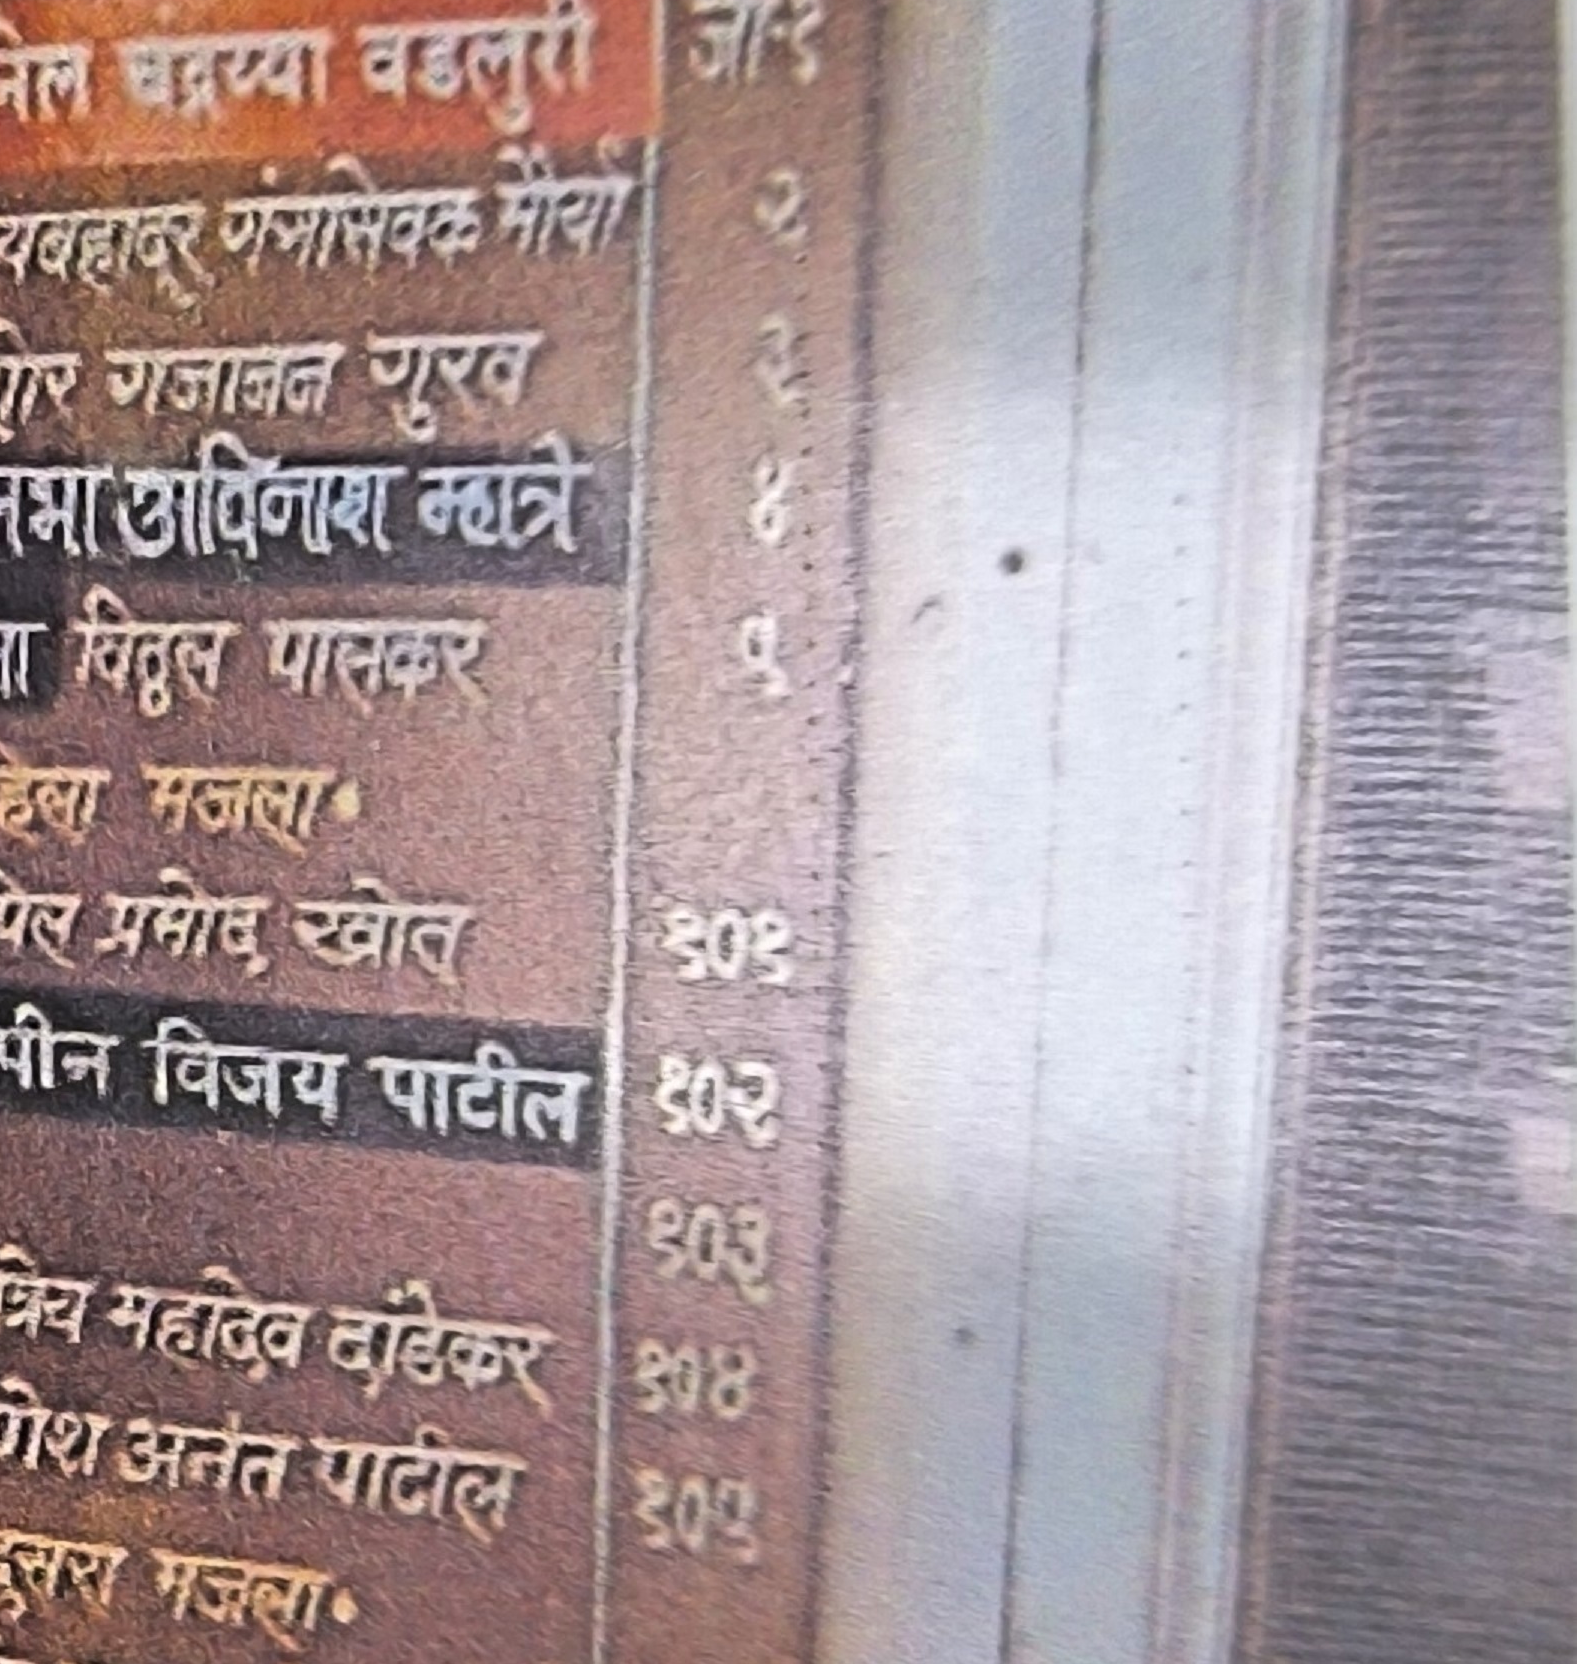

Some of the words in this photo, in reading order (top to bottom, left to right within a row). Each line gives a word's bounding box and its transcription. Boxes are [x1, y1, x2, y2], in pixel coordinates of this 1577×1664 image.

[105, 341, 347, 417] गजानन
[365, 331, 545, 441] गुरव
[113, 429, 409, 563] अविनाश
[417, 427, 595, 553] म्हात्रे
[141, 761, 337, 859] मजला
[141, 1013, 351, 1125] विजय
[363, 1037, 593, 1145] पाटील
[105, 1261, 315, 1385] महादेव
[121, 1411, 303, 1513] अनंत
[309, 1423, 529, 1543] पाटील
[147, 1547, 335, 1653] मजला
